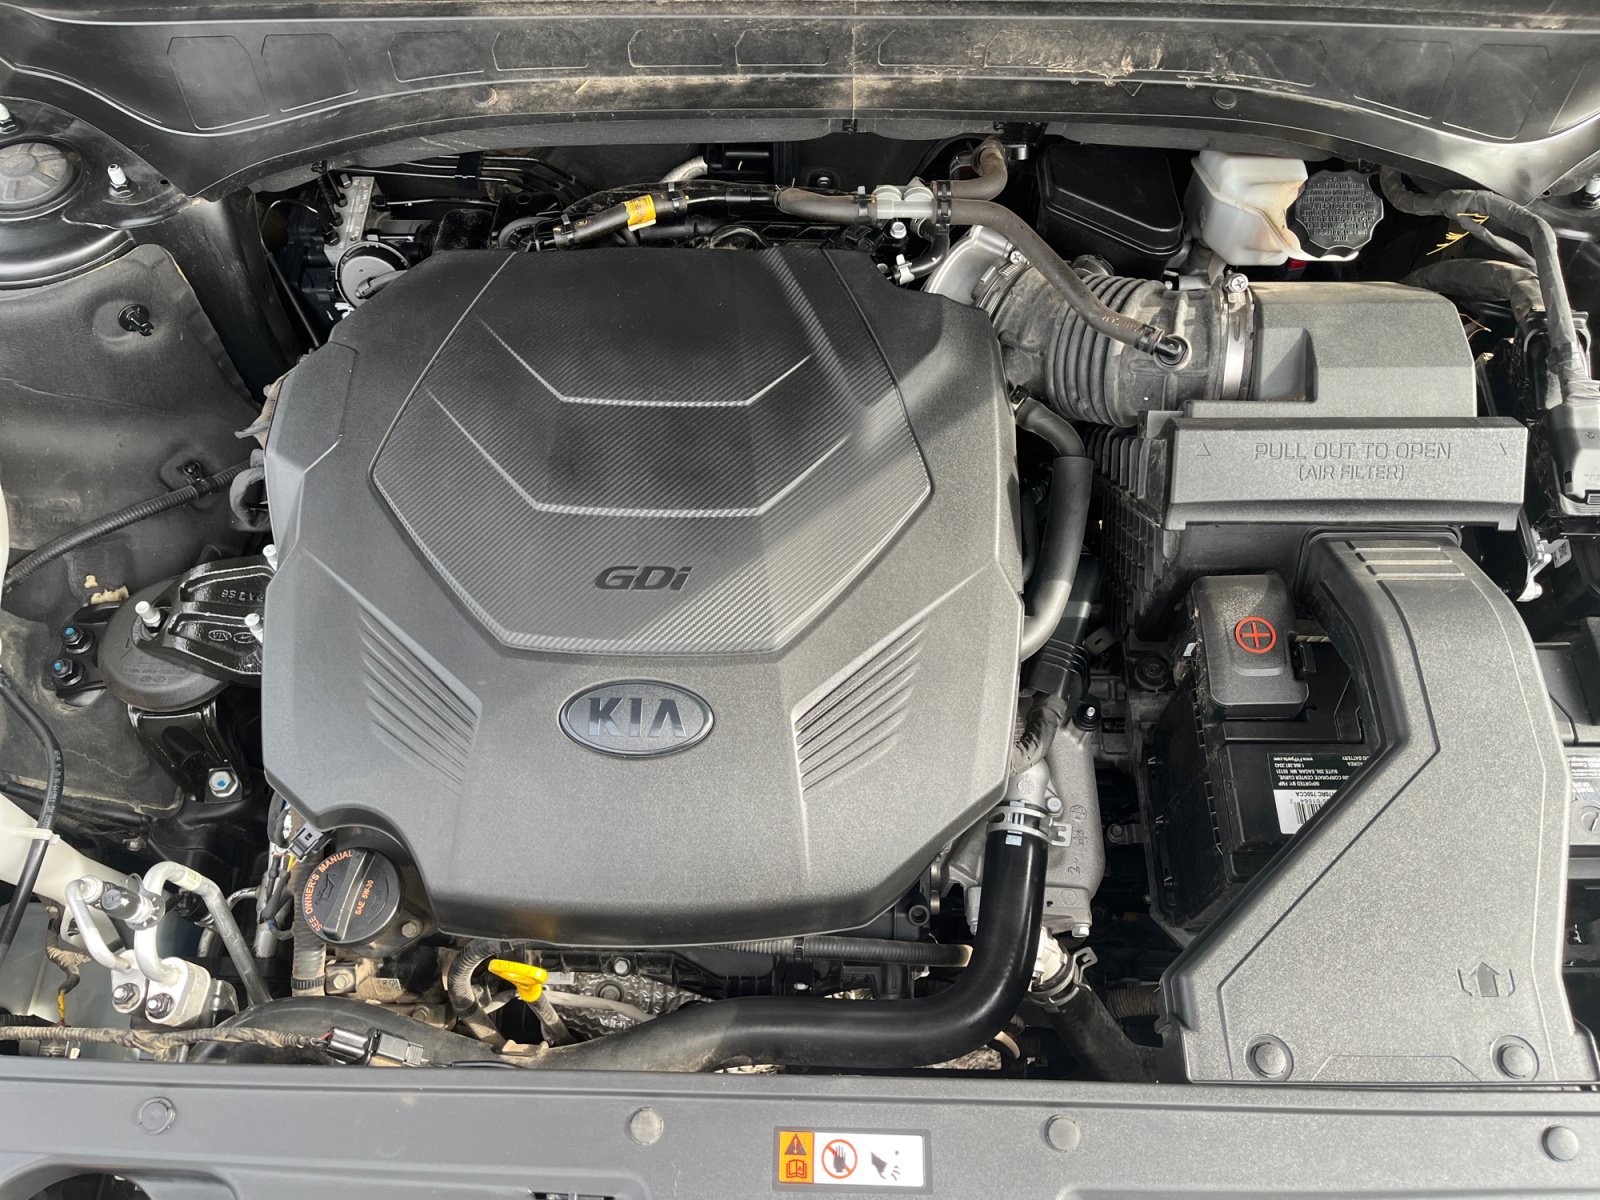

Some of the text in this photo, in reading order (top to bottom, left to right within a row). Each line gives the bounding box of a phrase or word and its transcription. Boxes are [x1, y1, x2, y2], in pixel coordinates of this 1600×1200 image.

[1254, 442, 1451, 460] PULL OUT TO OPEN
[595, 565, 693, 591] GDi
[587, 697, 687, 737] KIA
[304, 849, 353, 932] SEE OWNER'S MANUAL
[354, 900, 366, 916] SAE
